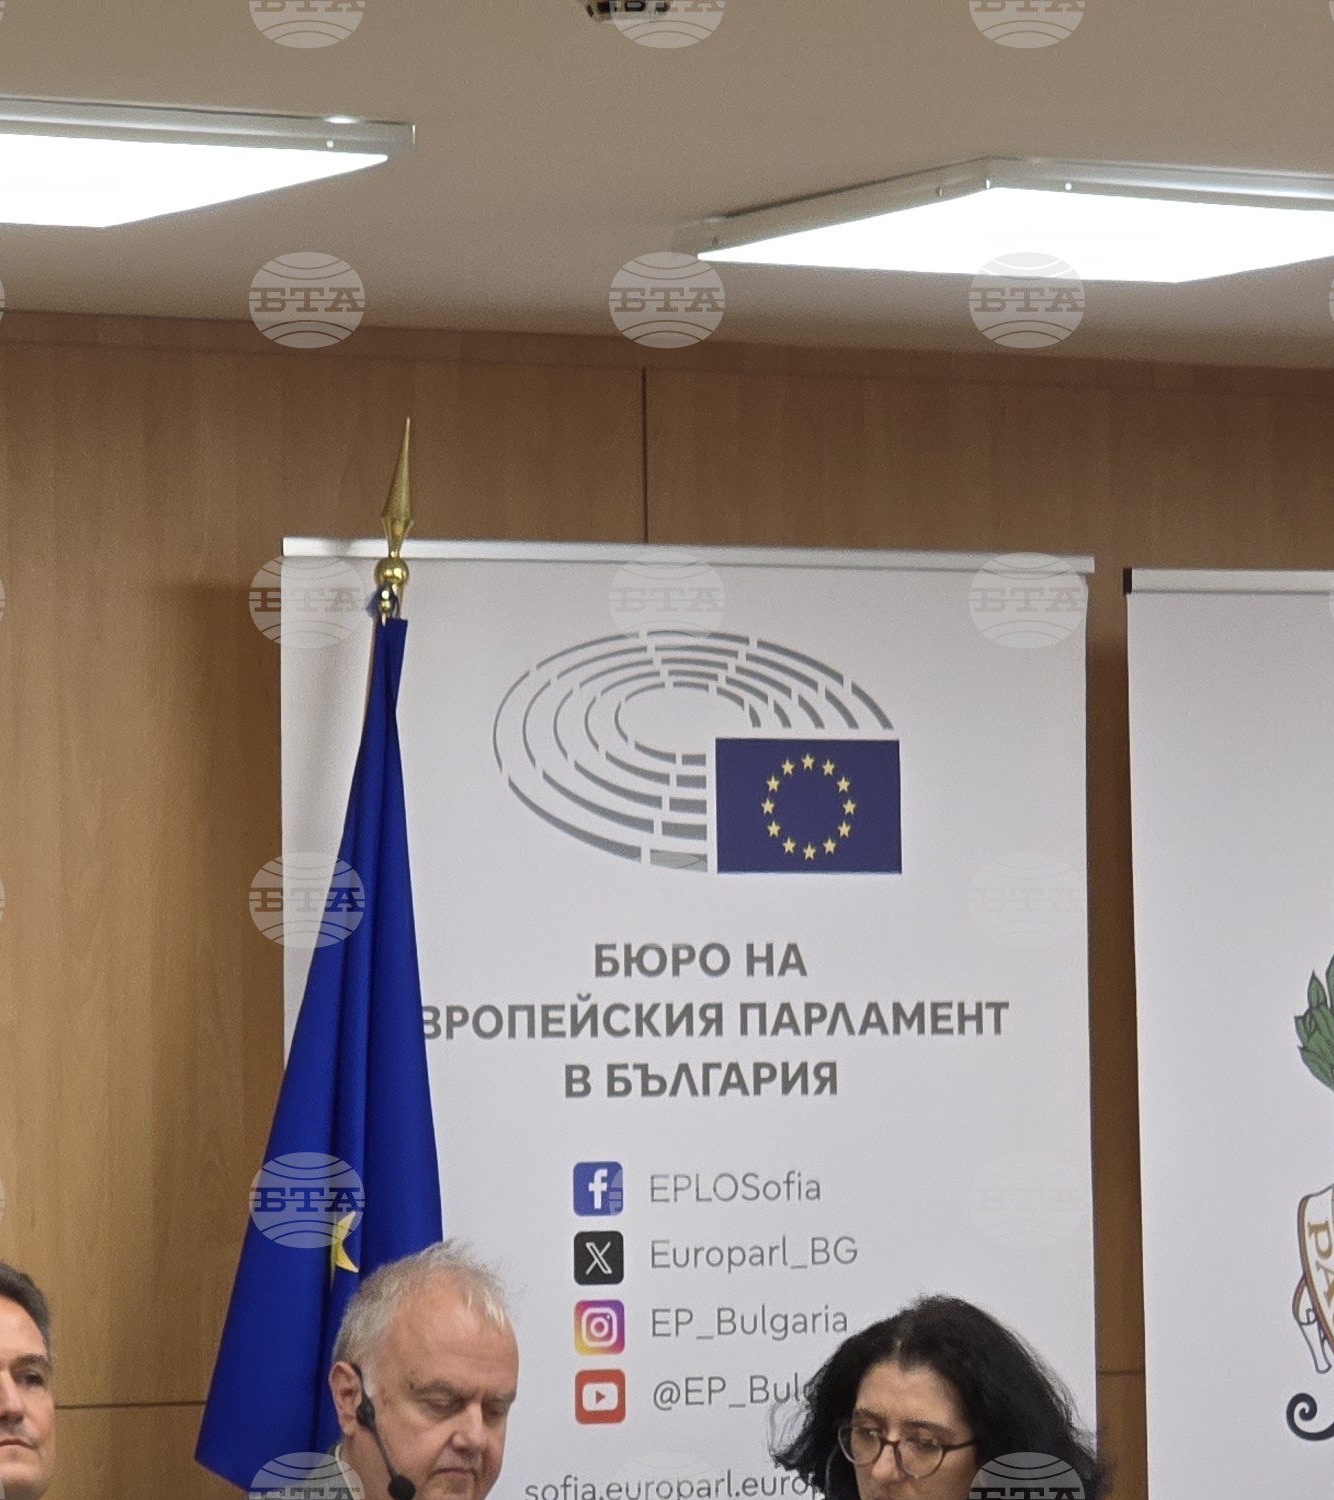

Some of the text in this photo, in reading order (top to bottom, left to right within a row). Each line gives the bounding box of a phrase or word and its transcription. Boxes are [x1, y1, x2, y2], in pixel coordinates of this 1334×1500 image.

[594, 942, 808, 978] БЮРО НА
[423, 992, 1010, 1041] ВРОПЕЙСКИЯ ПАРЛАМЕНТ
[564, 1061, 838, 1099] В БЪЛГАРИЯ
[650, 1170, 822, 1204] EPLOSofia
[650, 1235, 859, 1274] Europarl_BG
[651, 1303, 849, 1341] EP_Bulgaria
[653, 1372, 811, 1411] @EP_Bul
